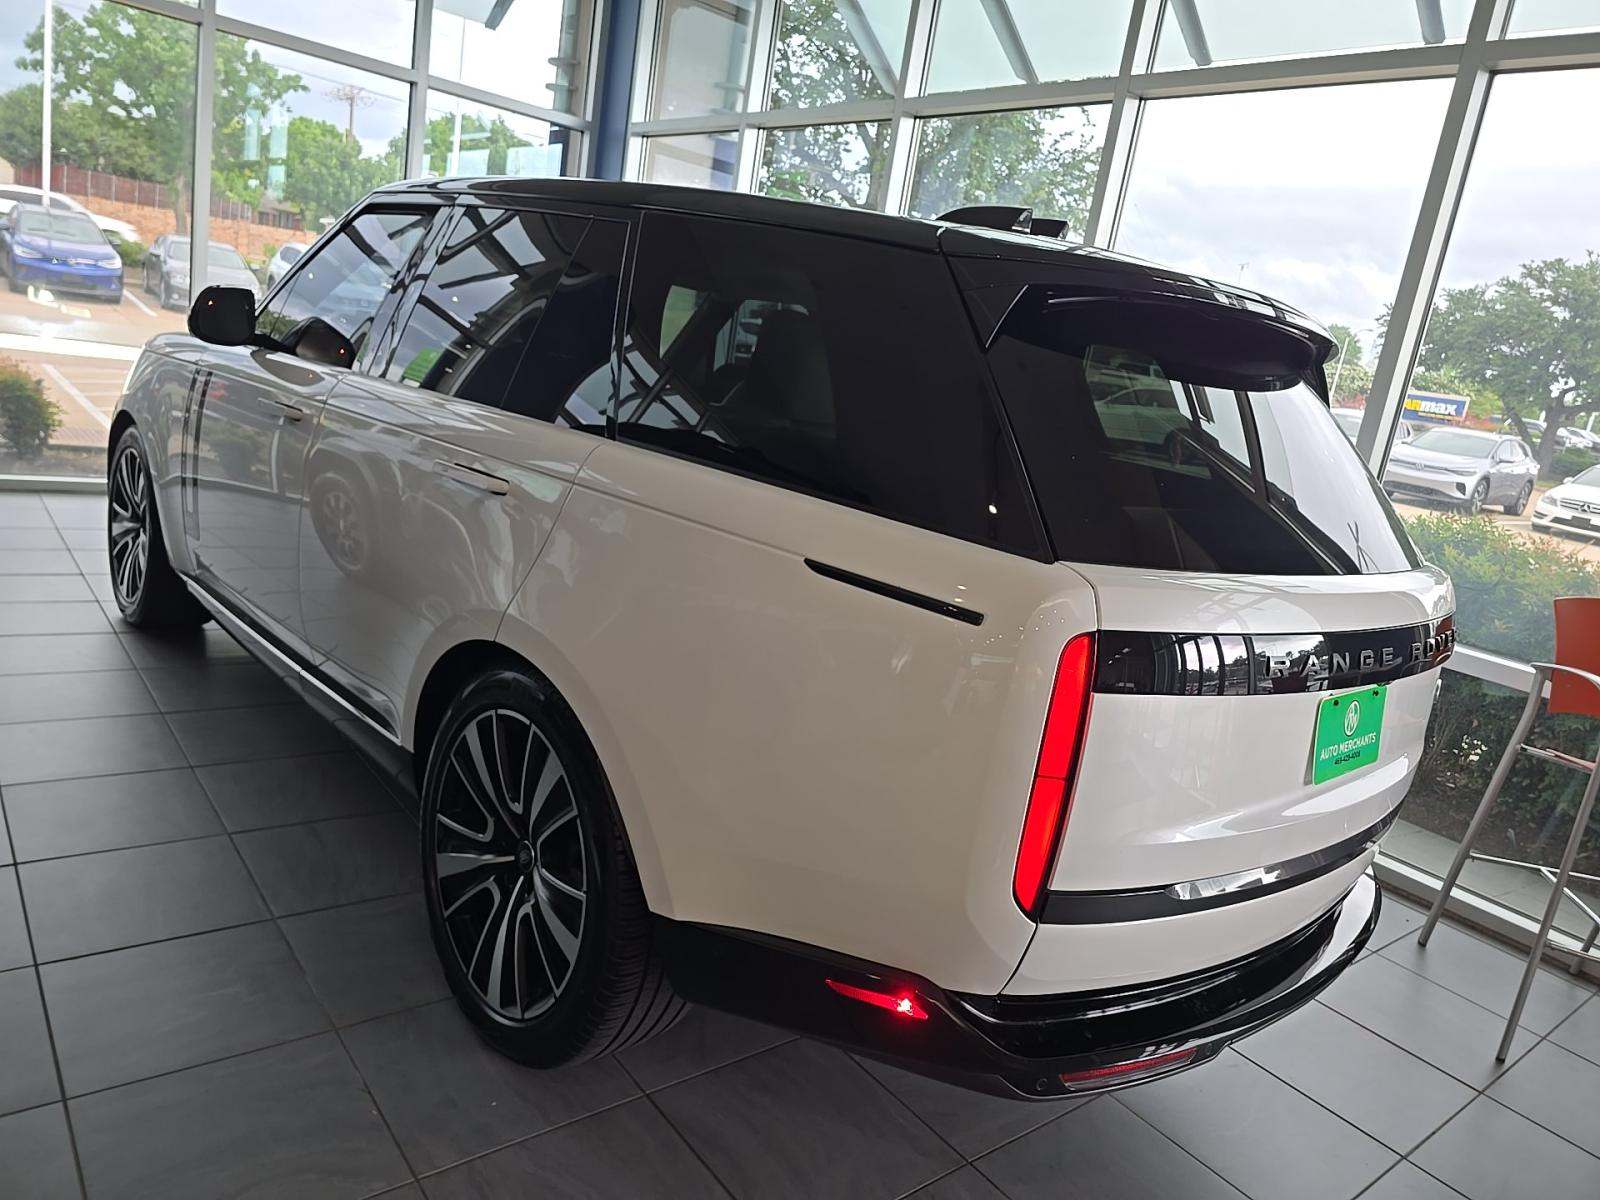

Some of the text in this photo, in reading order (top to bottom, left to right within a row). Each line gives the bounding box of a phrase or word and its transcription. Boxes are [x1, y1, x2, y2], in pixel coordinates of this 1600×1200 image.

[1266, 630, 1454, 677] RANGE ROVE
[1320, 732, 1376, 760] AUTO MERCHANTS
